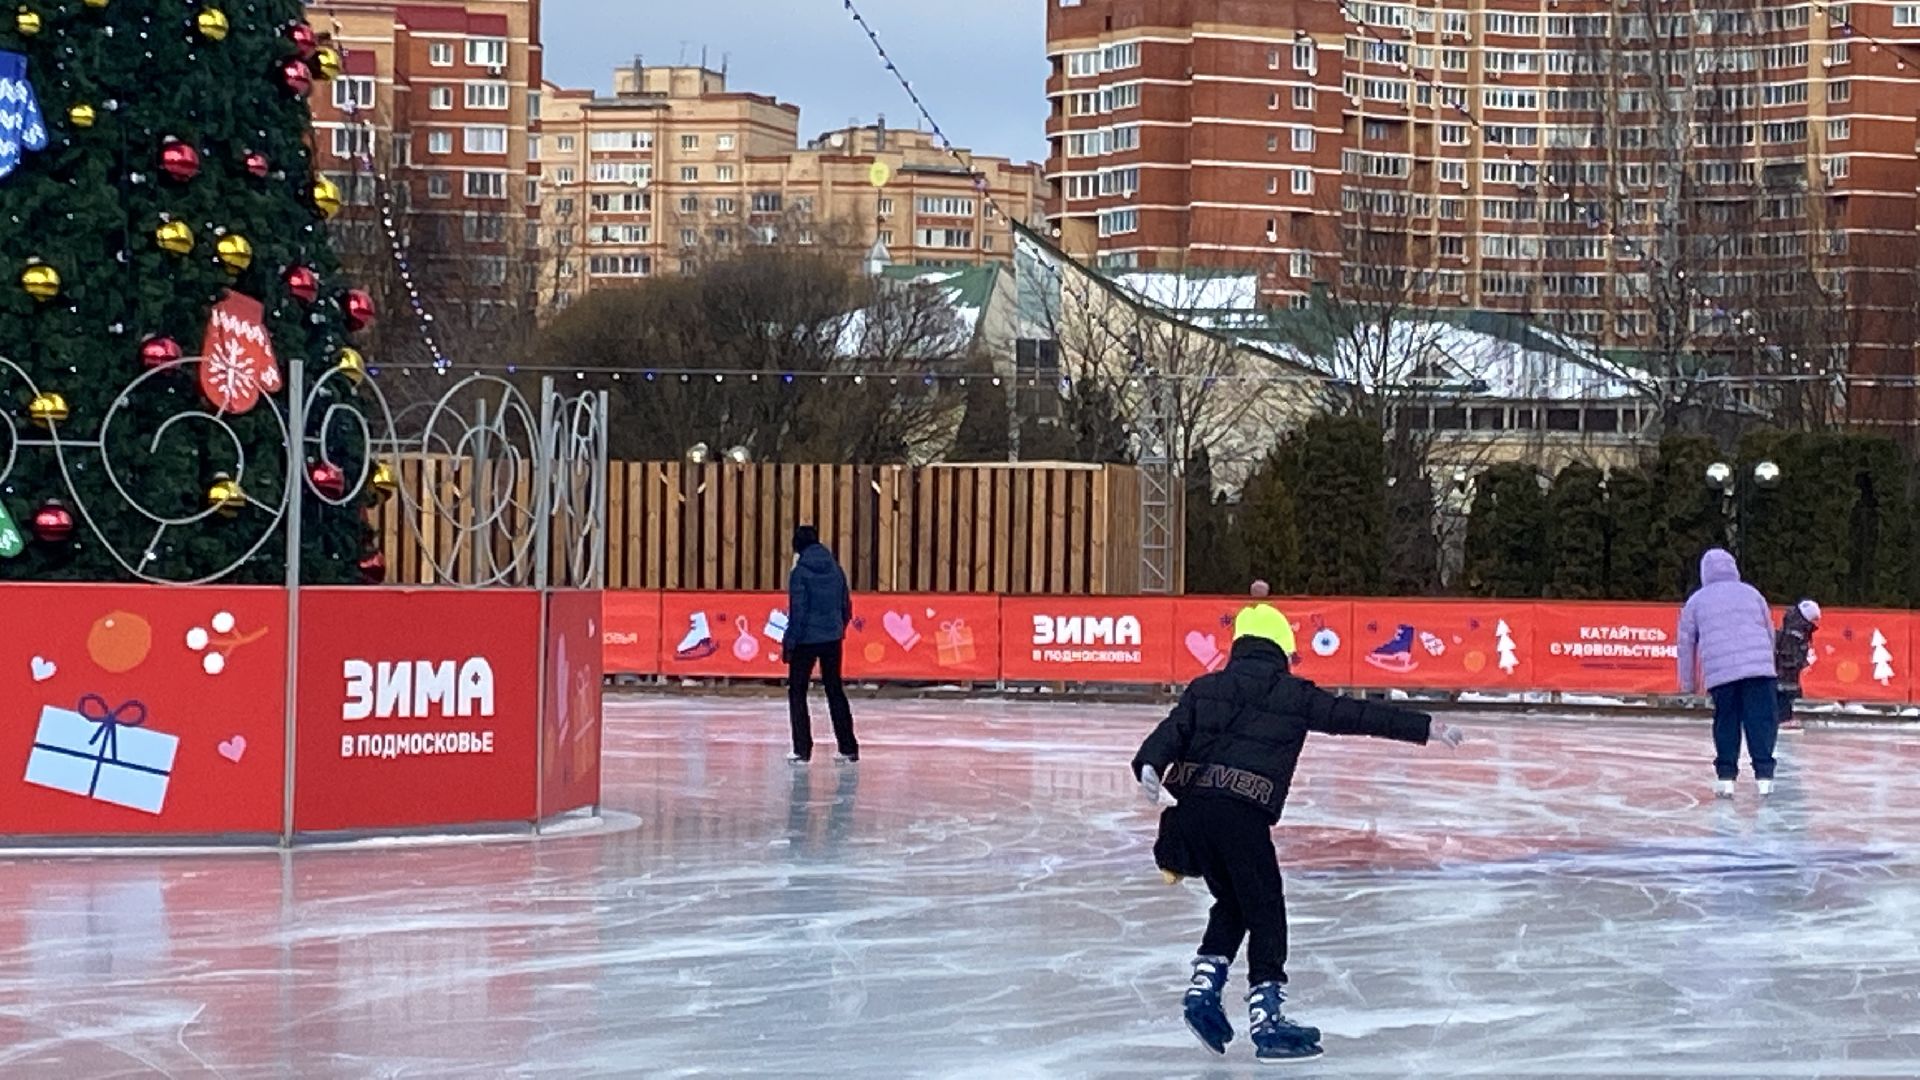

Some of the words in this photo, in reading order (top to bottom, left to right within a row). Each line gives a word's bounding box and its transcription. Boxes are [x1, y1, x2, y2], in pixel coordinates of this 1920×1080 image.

[1032, 615, 1141, 645] ЗИМА
[1580, 625, 1667, 641] КАТАЙТЕСЬ
[1563, 643, 1678, 658] УДОВОЛЬСТВИЕ
[342, 656, 494, 720] ЗИМА
[341, 734, 354, 757] В
[357, 731, 494, 759] ПОДМОСКОВЬЕ
